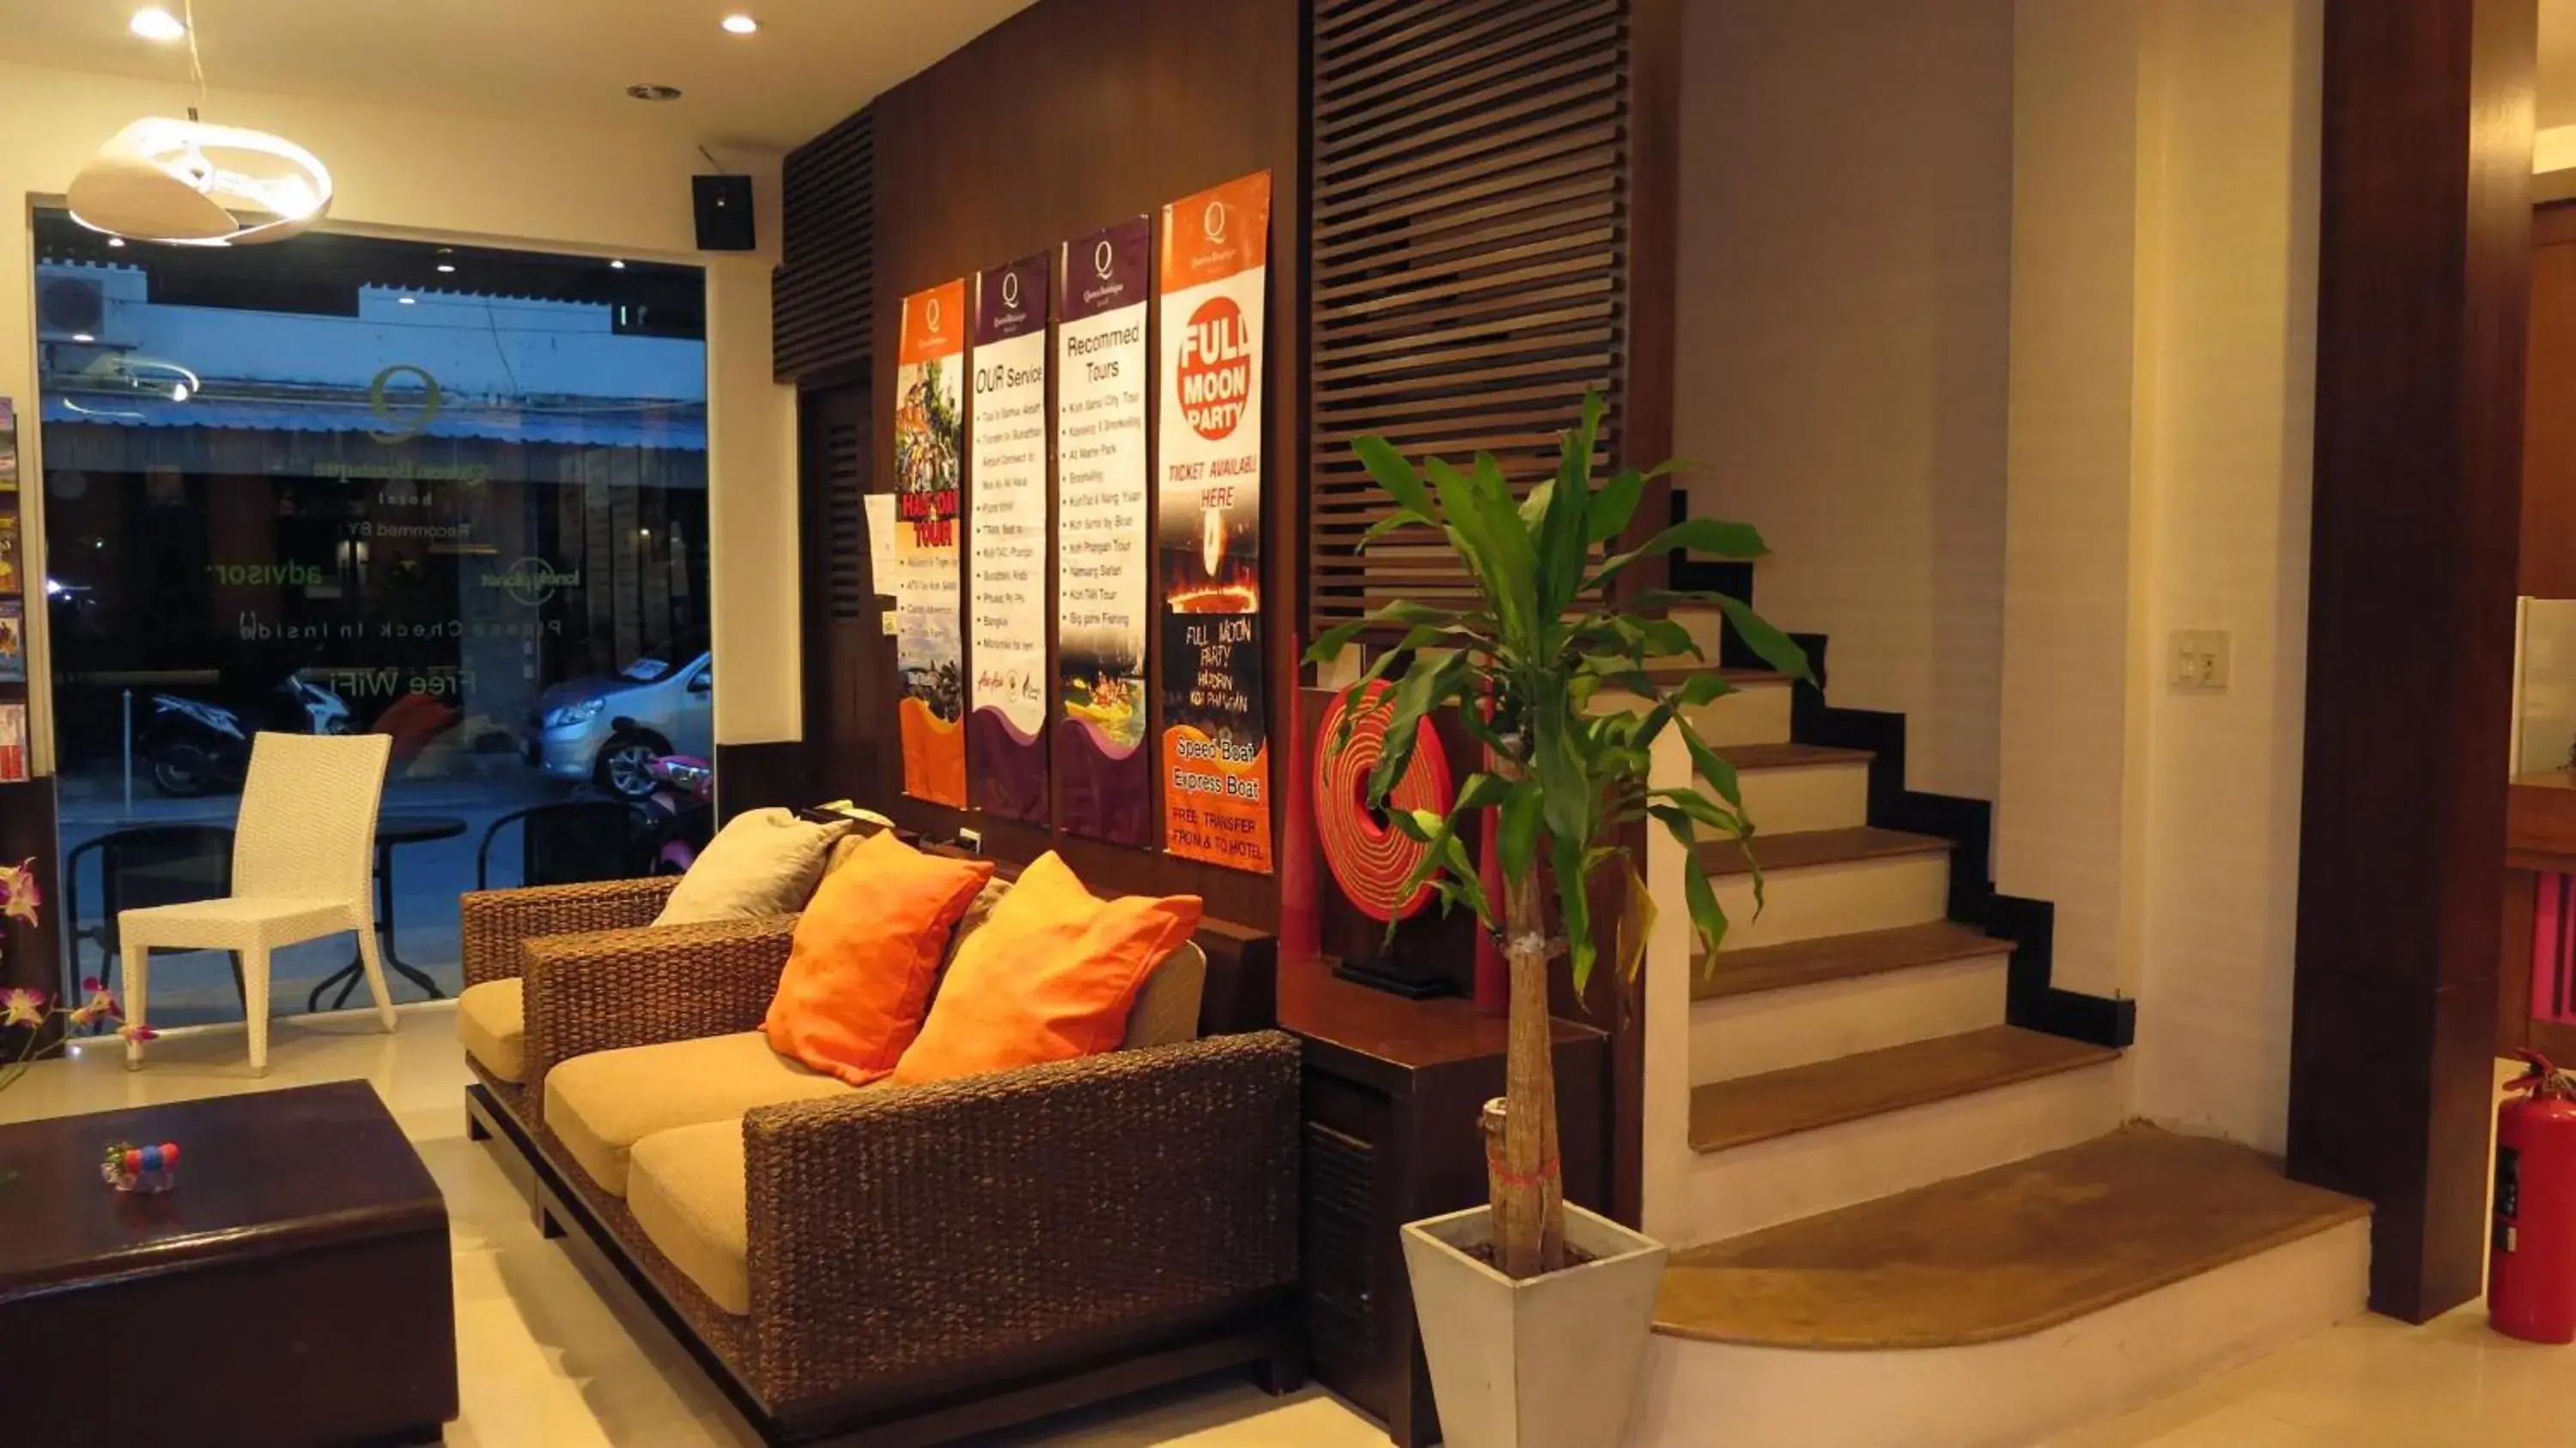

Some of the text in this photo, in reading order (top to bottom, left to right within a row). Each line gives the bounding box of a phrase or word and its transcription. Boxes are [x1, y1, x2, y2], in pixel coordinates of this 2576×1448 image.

[1204, 201, 1226, 244] Q
[1095, 240, 1113, 280] Q
[1002, 271, 1019, 308] Q
[926, 298, 940, 334] Q
[1067, 322, 1139, 357] Recommed
[1180, 313, 1250, 369] FULL
[975, 364, 1004, 394] OUR
[1085, 361, 1120, 382] Tours
[1183, 364, 1247, 405] MOON
[1187, 400, 1244, 431] PARTY
[1169, 461, 1205, 482] TICKET
[1201, 485, 1235, 509] HERE
[913, 520, 953, 548] TOUR
[1218, 617, 1251, 643] MOON
[1200, 645, 1231, 668] PARTY
[1177, 737, 1255, 763] Speed Boat
[1173, 767, 1259, 799] Express Boat
[1172, 806, 1256, 834] FREE TRANSFER
[1172, 829, 1201, 847] FROM
[1214, 836, 1228, 854] TO
[1229, 839, 1263, 860] HOTEL
